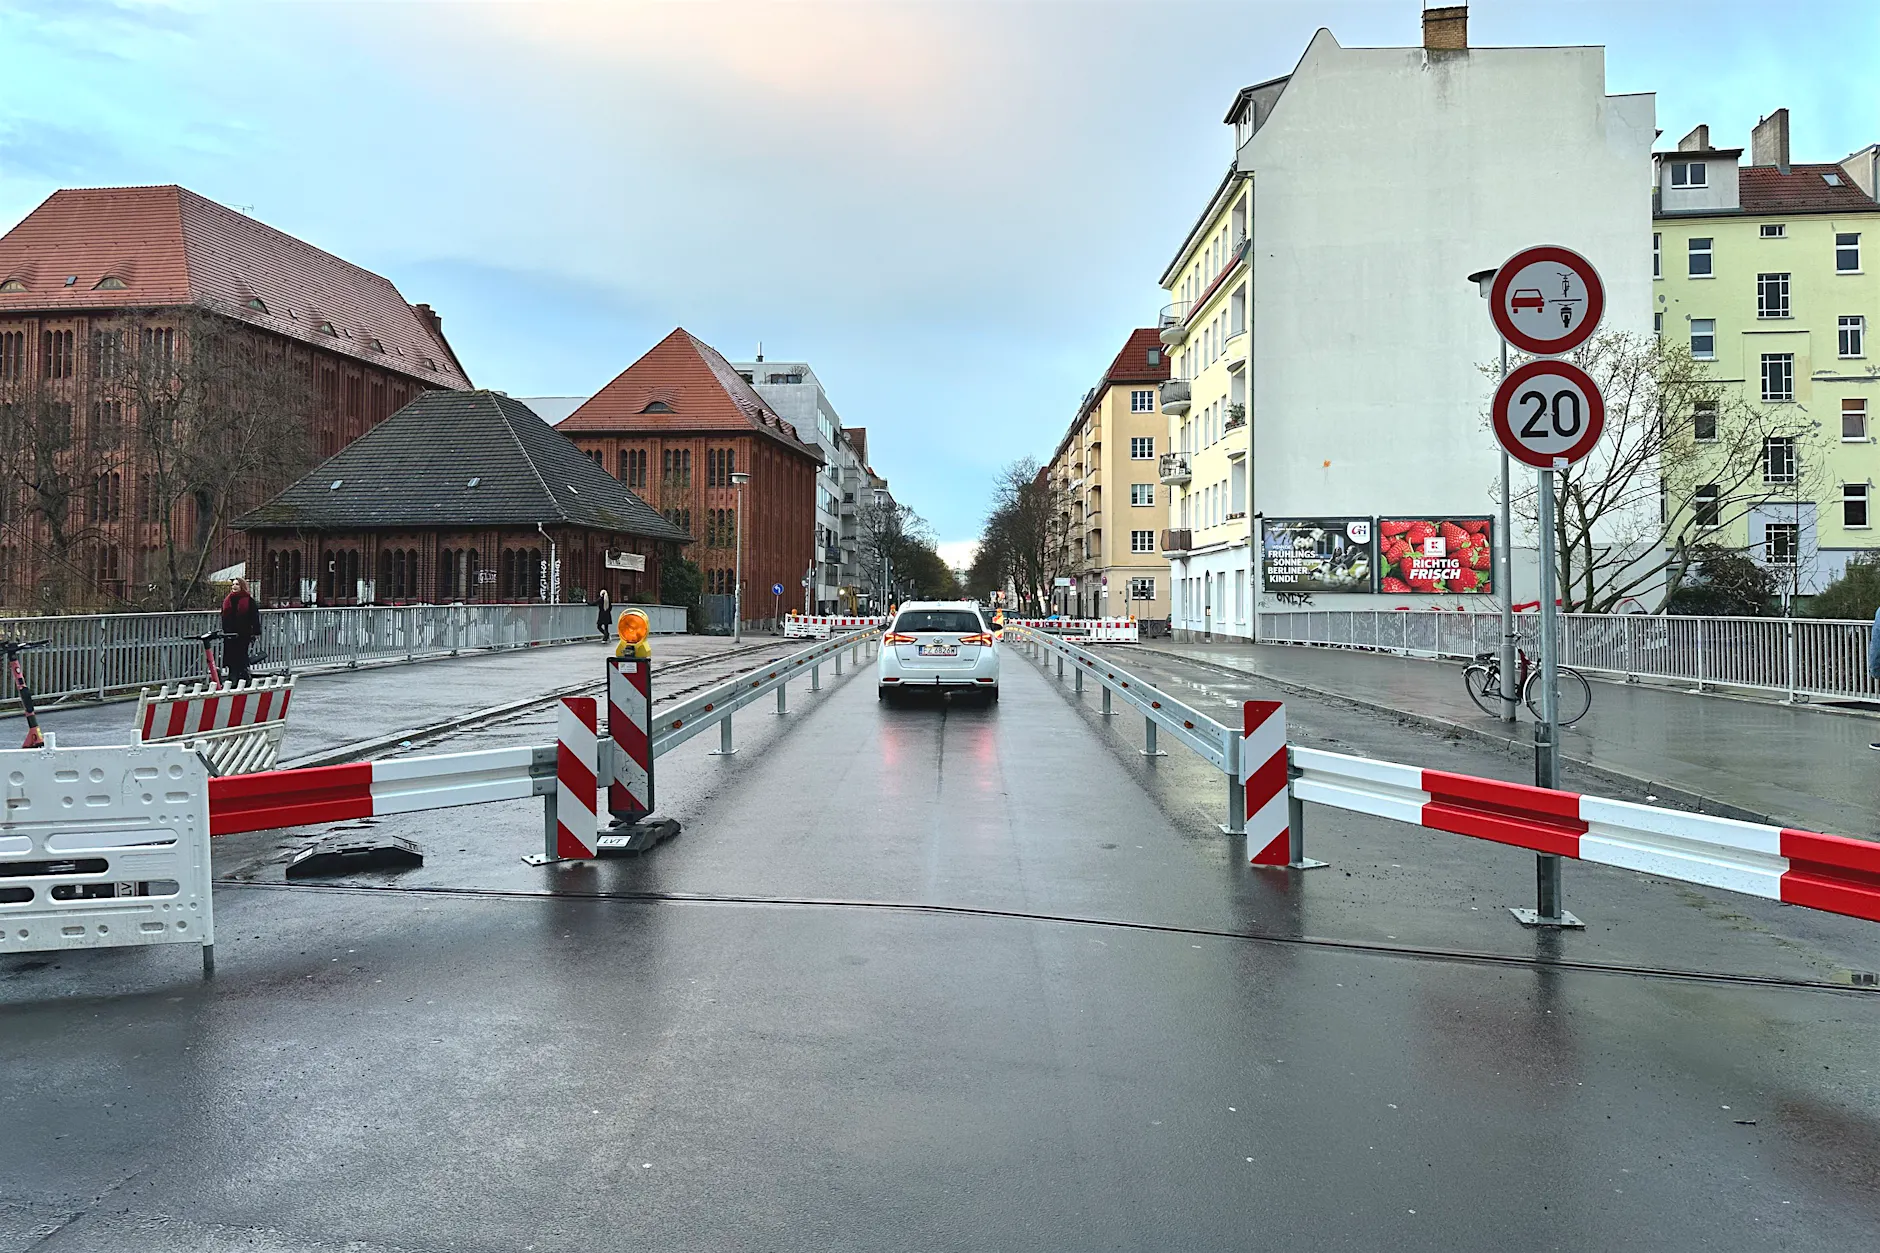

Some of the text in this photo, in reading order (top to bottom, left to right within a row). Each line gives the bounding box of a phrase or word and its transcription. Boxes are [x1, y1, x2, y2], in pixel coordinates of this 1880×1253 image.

[1519, 390, 1580, 438] 20
[1273, 558, 1302, 566] SONNE
[1412, 558, 1460, 568] RICHTIG
[1269, 575, 1299, 583] KINDL!
[1409, 568, 1461, 580] FRISCH
